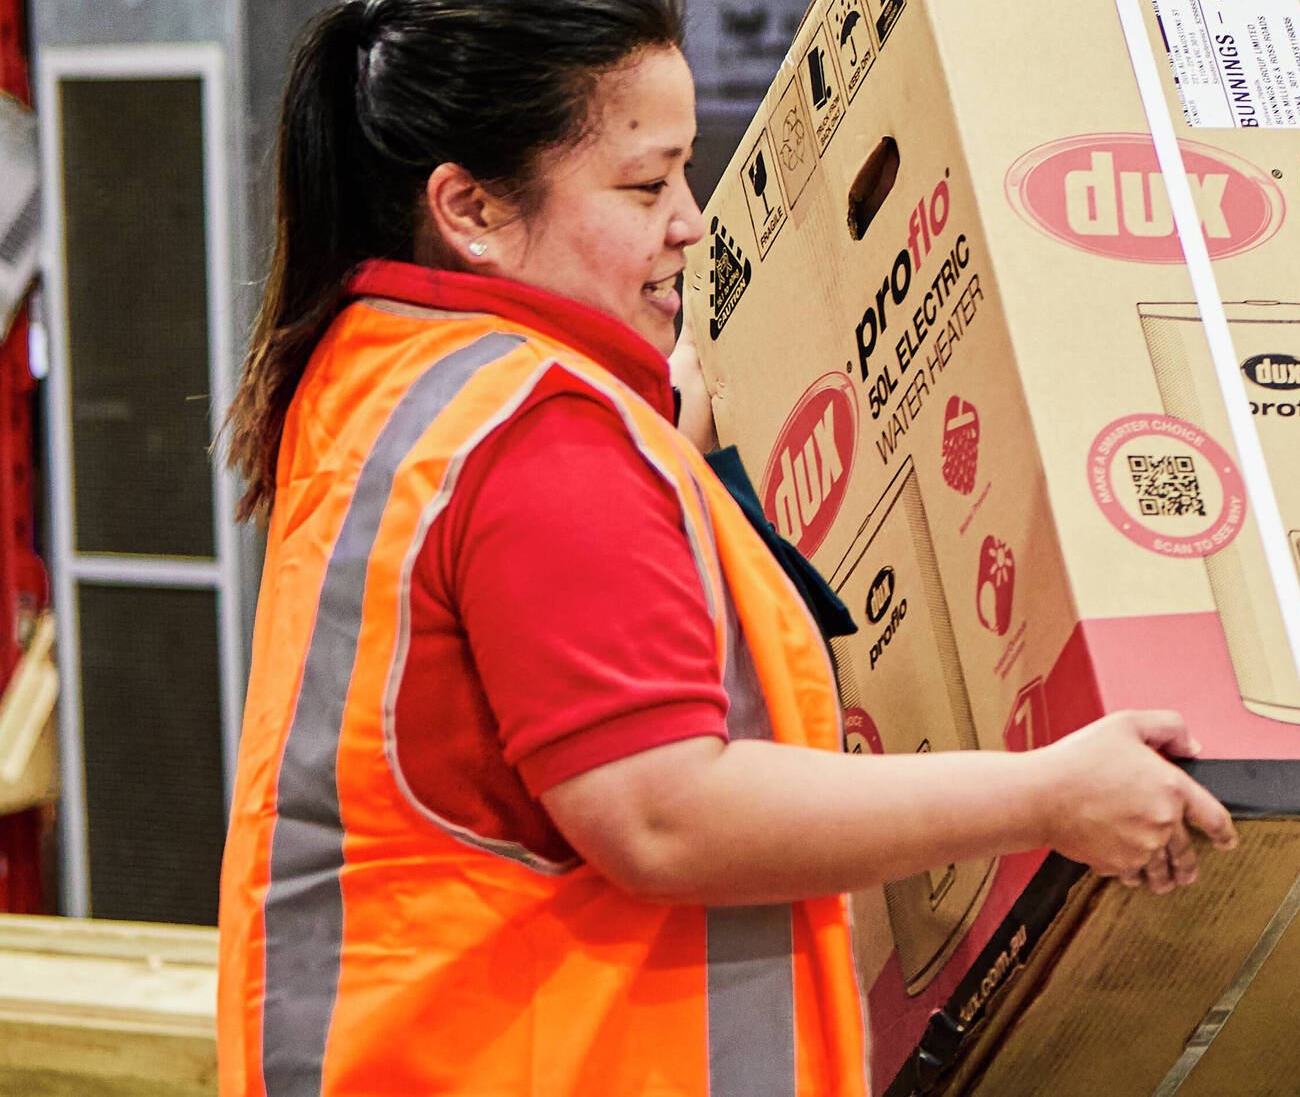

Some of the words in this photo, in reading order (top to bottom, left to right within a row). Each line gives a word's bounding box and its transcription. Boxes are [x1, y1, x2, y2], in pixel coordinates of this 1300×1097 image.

[1246, 23, 1262, 54] LIMITED
[860, 50, 872, 71] DRY
[1255, 56, 1271, 82] GROUP
[1214, 34, 1259, 127] BUNNINGS
[1274, 74, 1291, 106] MILLERS
[1264, 85, 1284, 124] BUNNINGS
[1064, 151, 1232, 239] dux
[759, 205, 783, 249] FRAGILE
[855, 179, 950, 383] proflo
[717, 278, 746, 330] CAUTION
[868, 365, 898, 420] 50L
[895, 234, 970, 374] ELECTRIC
[876, 368, 930, 466] WATER
[926, 274, 985, 385] HEATER
[1098, 419, 1150, 455] SMARTER
[1151, 419, 1206, 447] CHOICE
[775, 399, 843, 548] dux
[1095, 456, 1106, 465] A
[1094, 466, 1113, 504] MAKE
[1153, 538, 1192, 554] SCAN
[1196, 539, 1213, 553] TO
[1211, 523, 1234, 545] SEE
[869, 598, 908, 670] proflo
